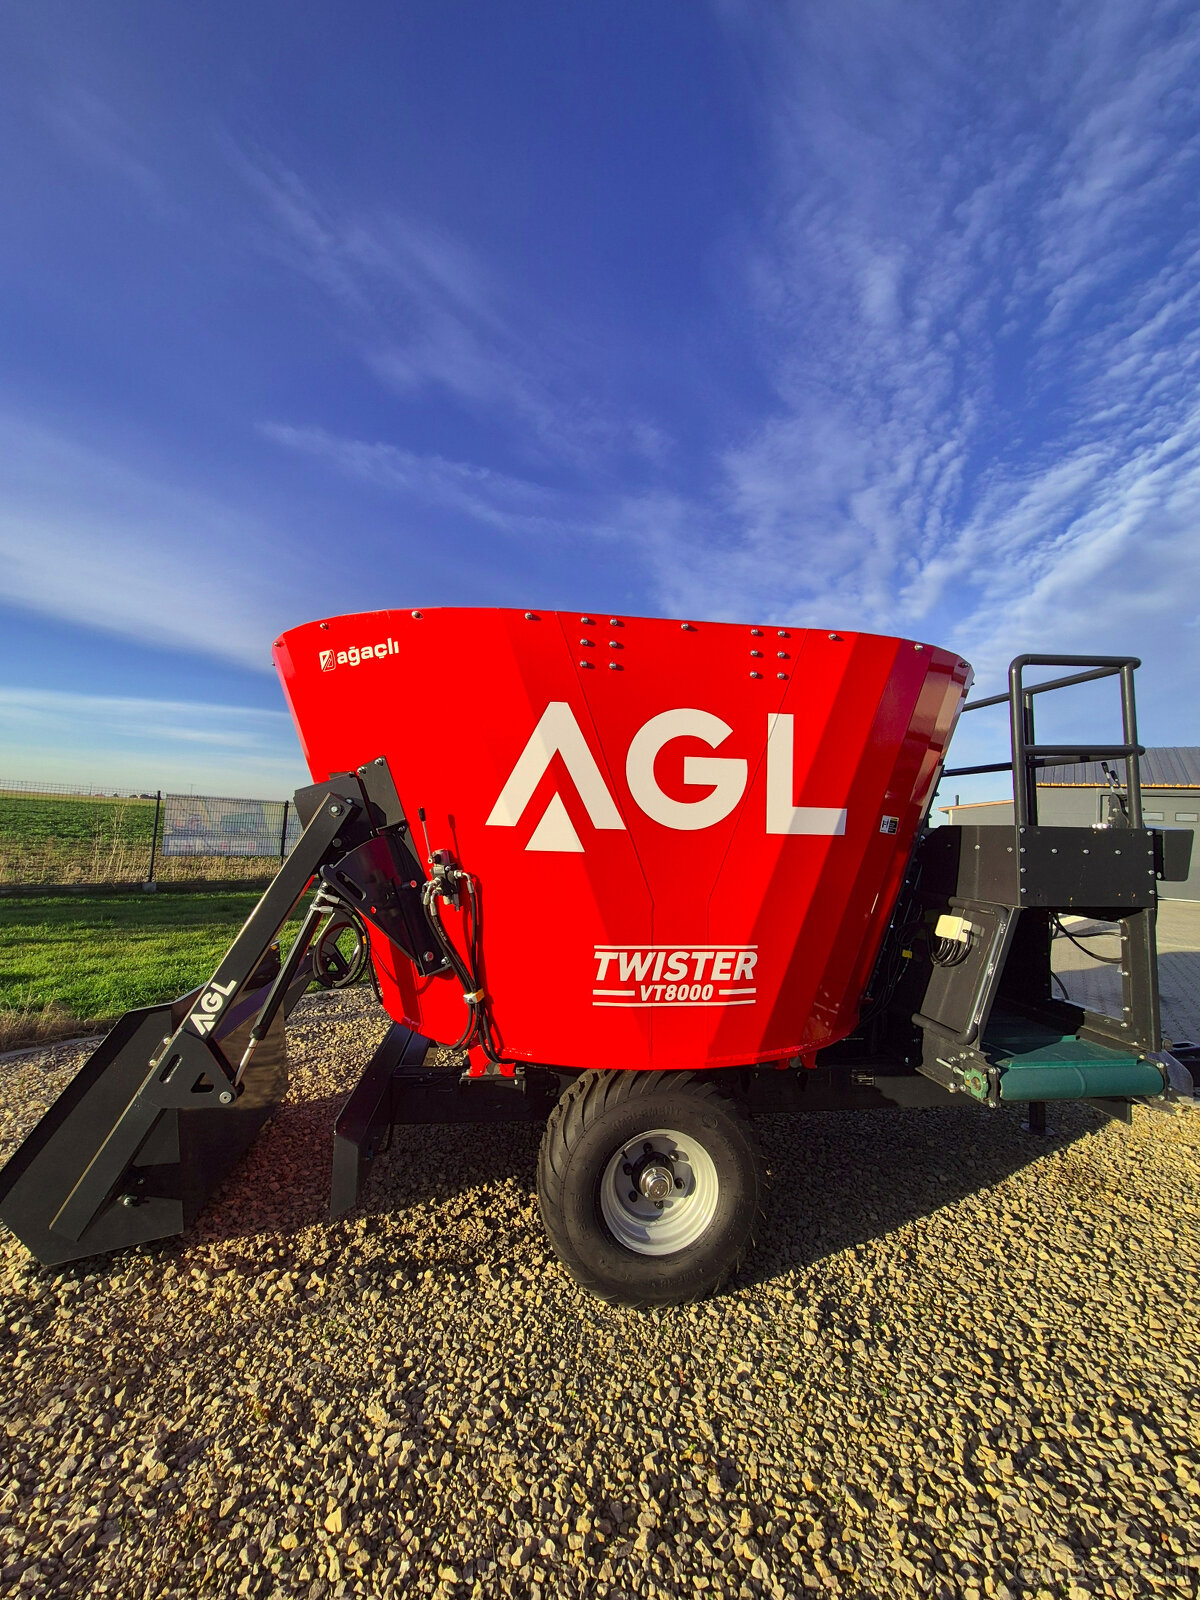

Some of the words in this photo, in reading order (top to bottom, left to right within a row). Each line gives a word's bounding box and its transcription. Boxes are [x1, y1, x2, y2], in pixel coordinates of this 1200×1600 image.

[336, 637, 399, 667] ağaçlı
[485, 701, 848, 853] AGL
[594, 951, 758, 982] TWISTER
[190, 979, 238, 1036] AGL
[640, 983, 714, 1002] VT8000
